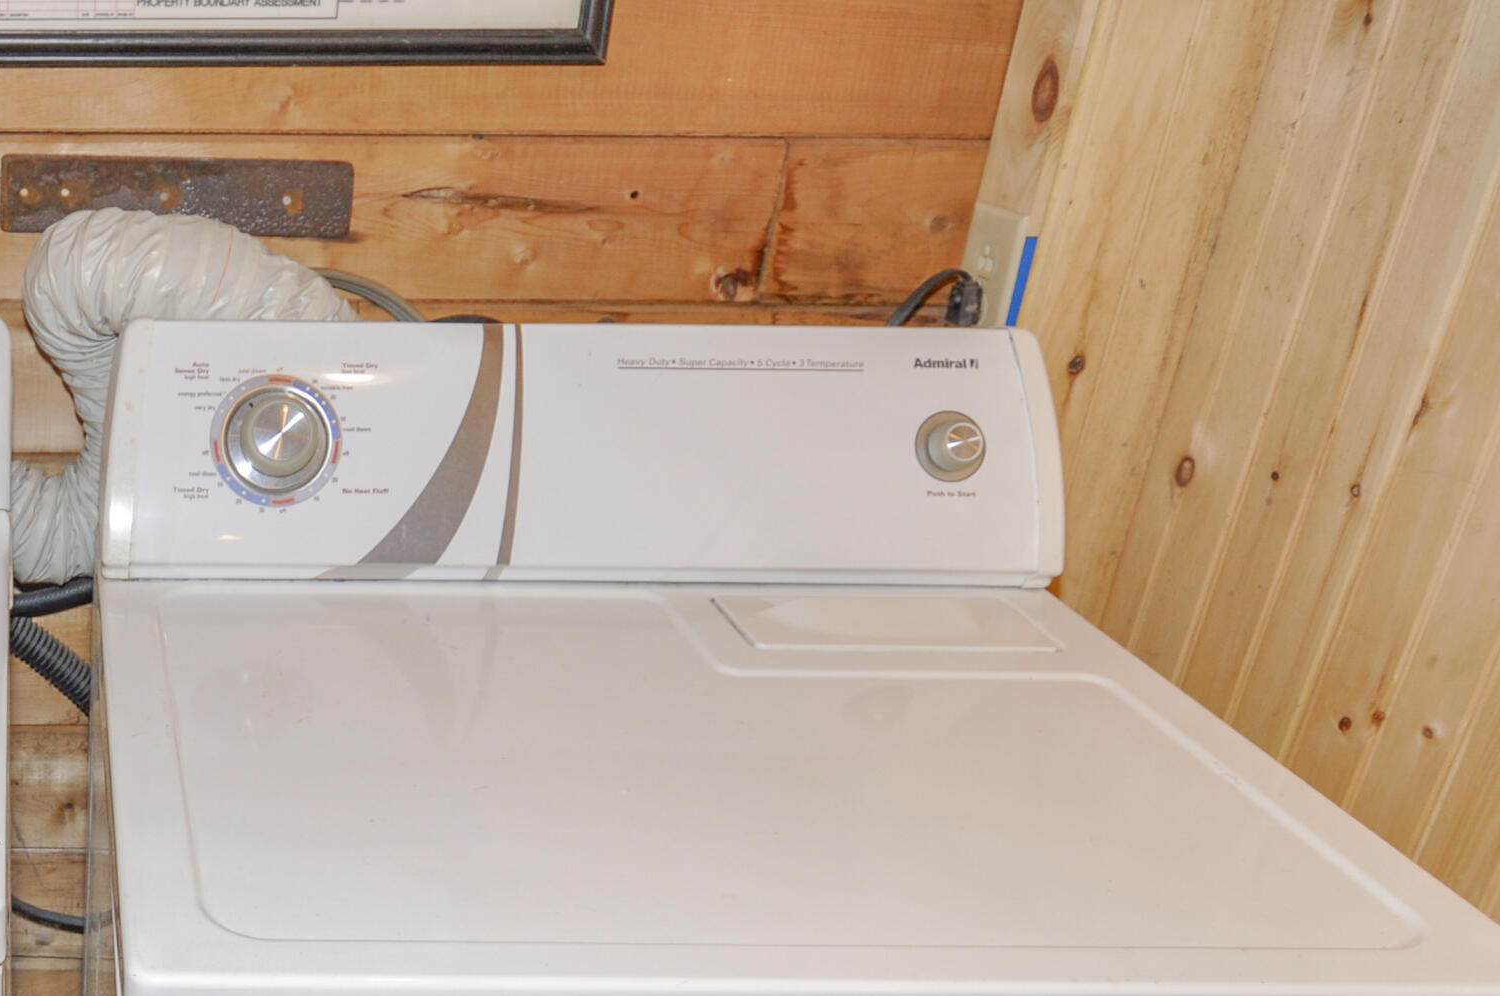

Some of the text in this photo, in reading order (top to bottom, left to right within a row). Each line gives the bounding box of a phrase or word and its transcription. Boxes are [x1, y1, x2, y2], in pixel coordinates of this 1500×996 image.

[616, 358, 646, 367] Heavy
[648, 357, 671, 367] Duty
[679, 357, 706, 367] Super
[709, 358, 749, 367] Capacity
[765, 359, 791, 368] Cycle
[806, 359, 865, 369] Temperature
[914, 357, 967, 369] Admiral
